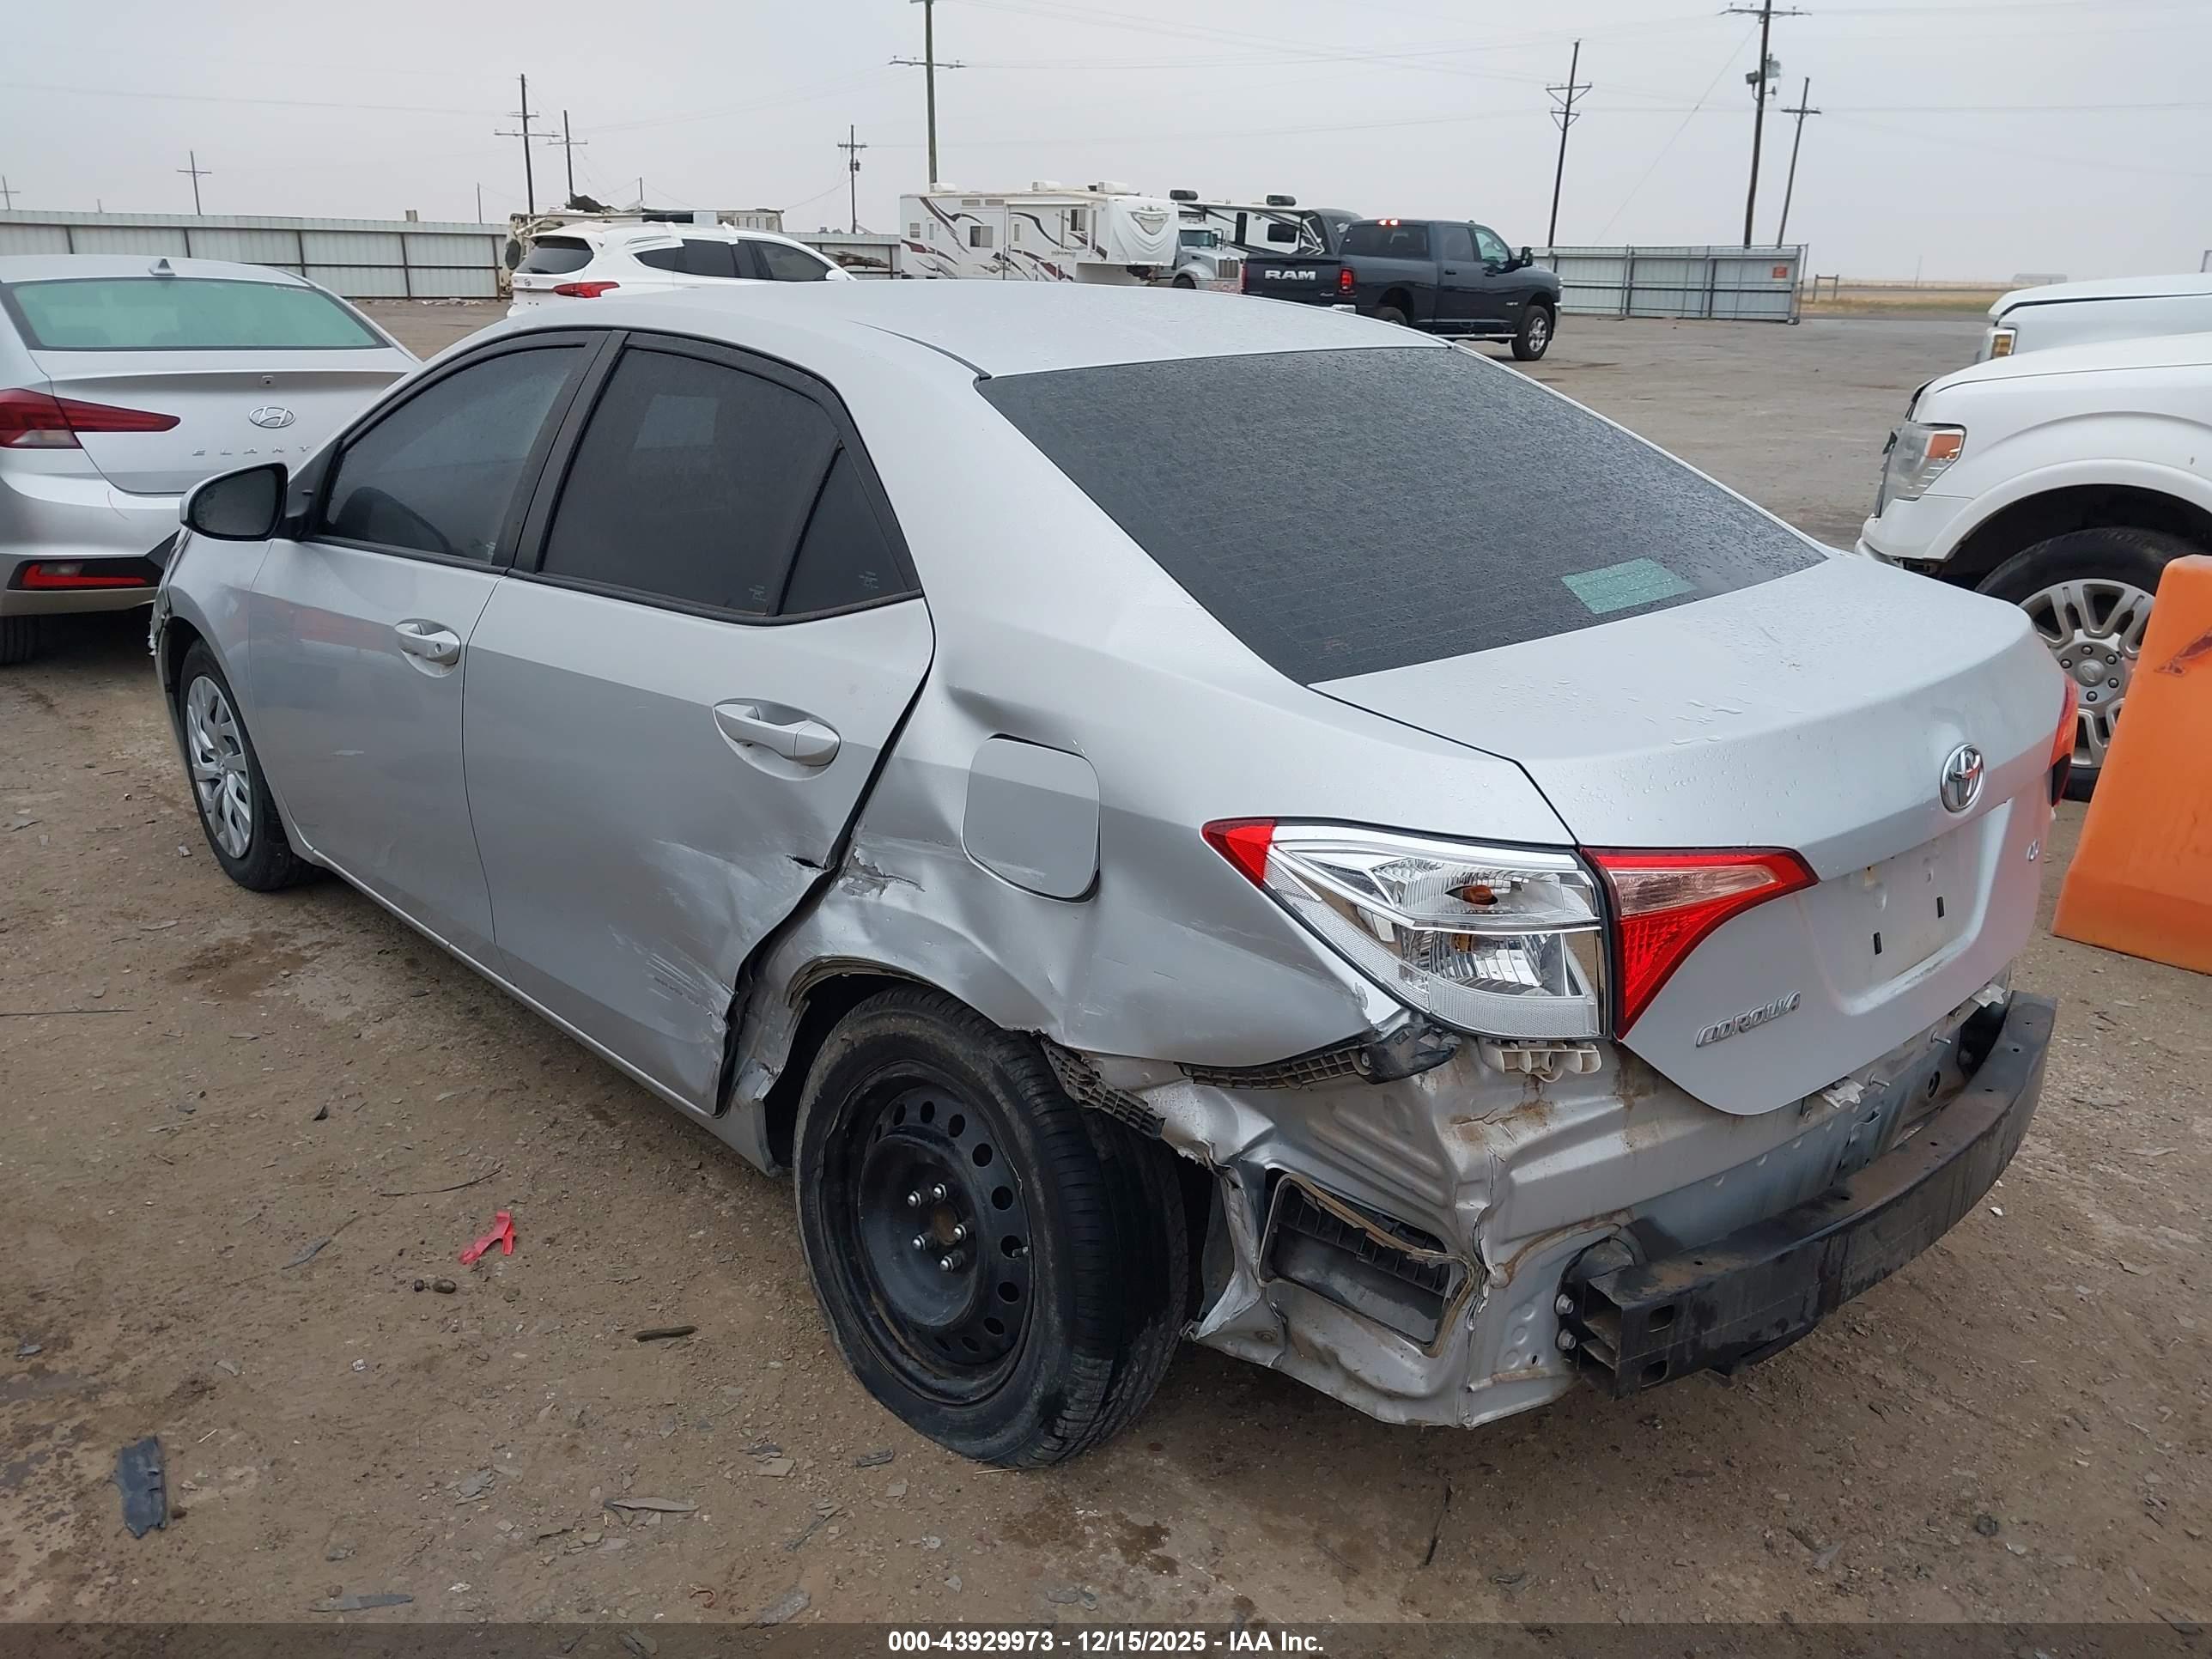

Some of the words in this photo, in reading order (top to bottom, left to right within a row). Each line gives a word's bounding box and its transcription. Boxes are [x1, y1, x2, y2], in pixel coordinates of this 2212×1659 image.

[1264, 270, 1316, 281] RAM
[191, 446, 312, 456] ELANT
[1695, 990, 1801, 1048] COROLLA
